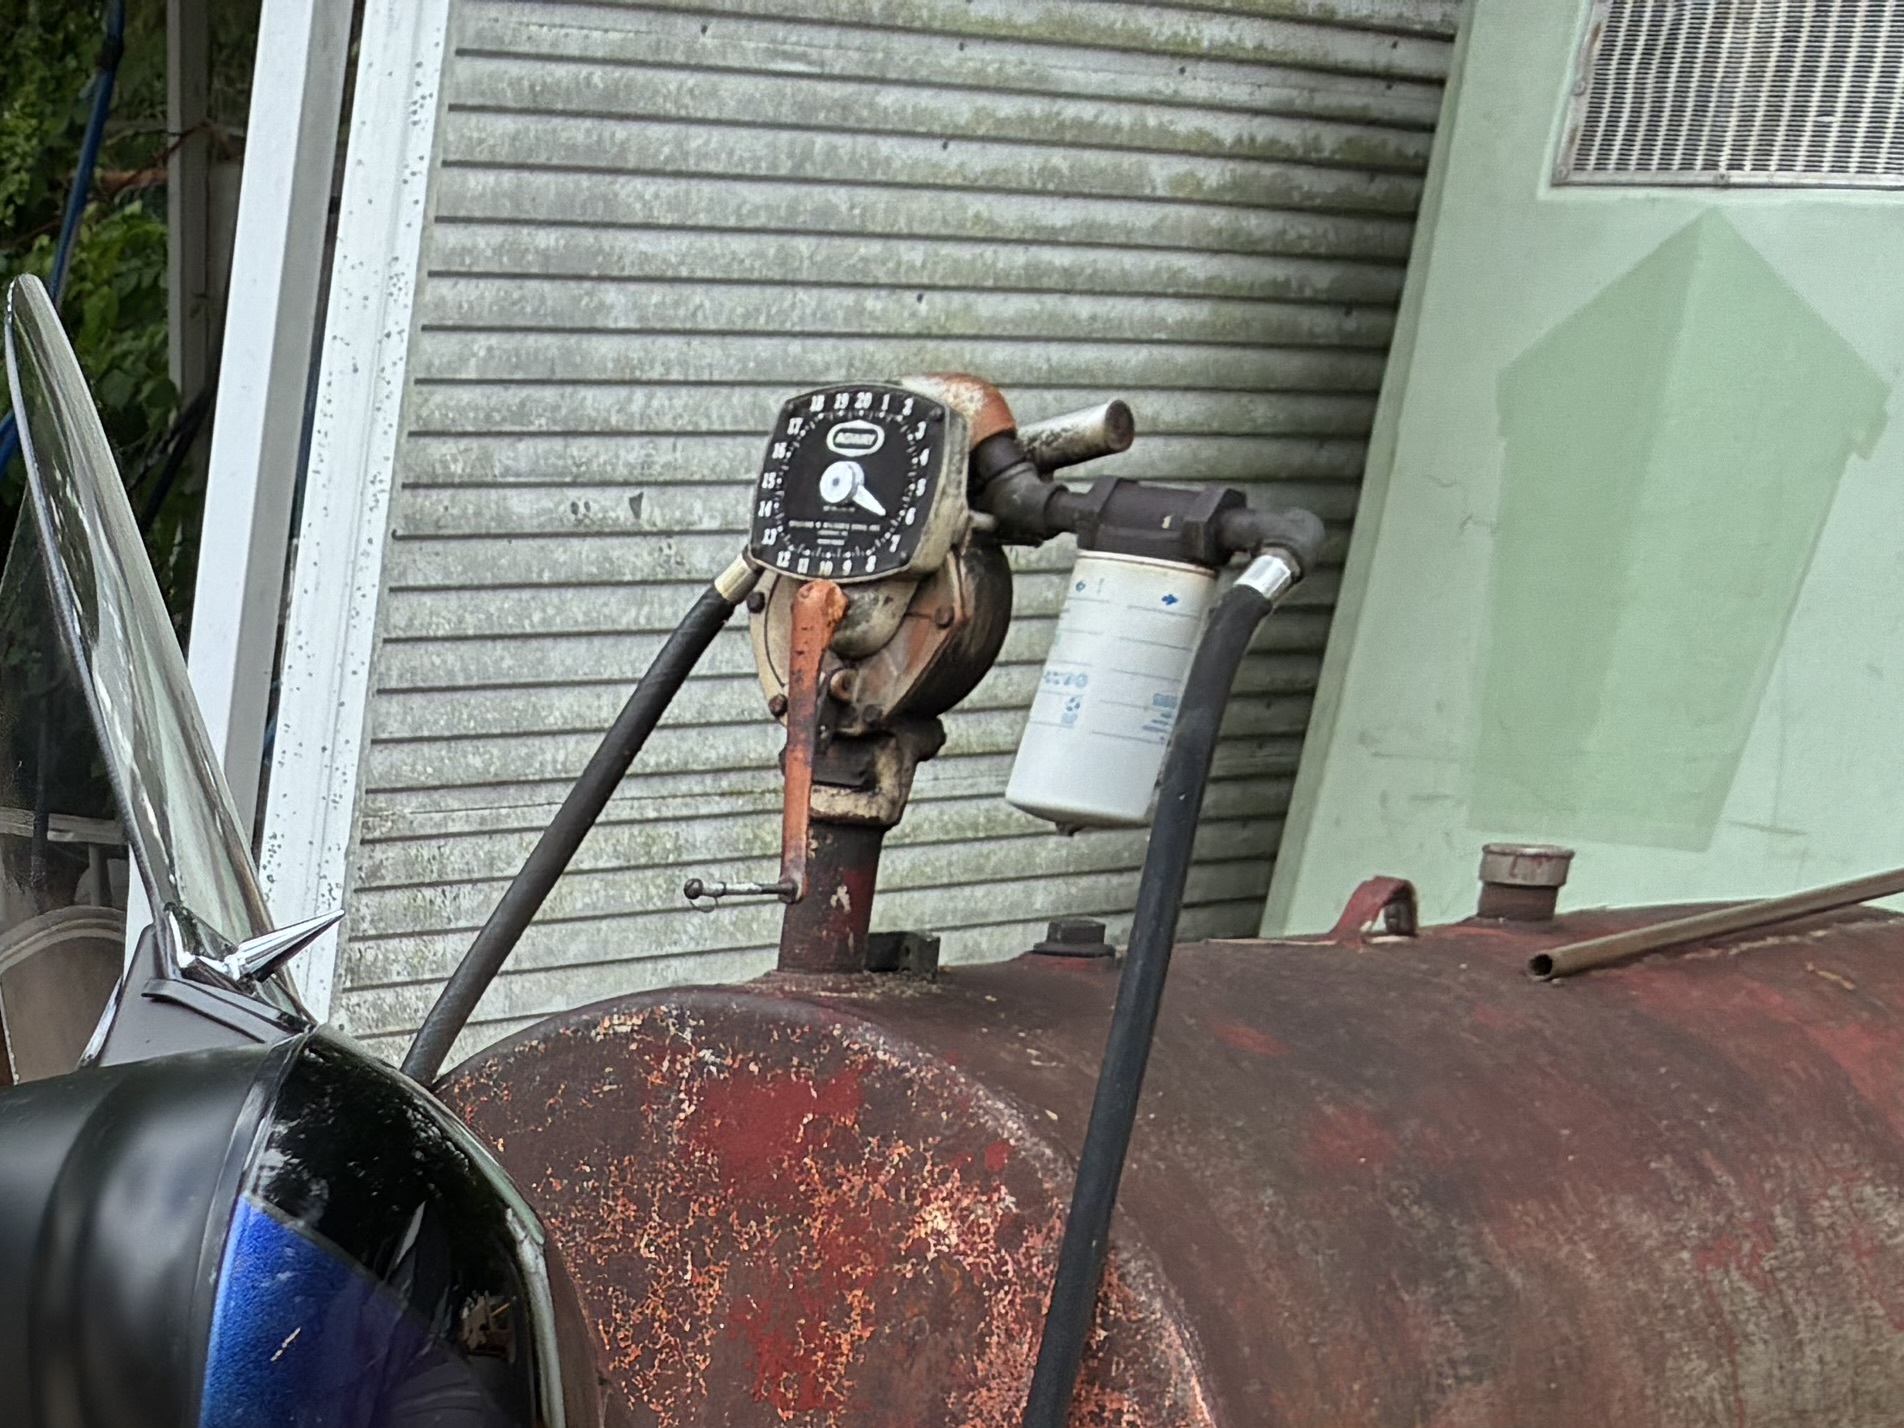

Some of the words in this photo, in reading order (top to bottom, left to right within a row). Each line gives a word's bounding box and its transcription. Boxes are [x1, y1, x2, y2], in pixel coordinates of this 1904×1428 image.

[834, 392, 850, 409] 19
[854, 391, 873, 409] 20
[881, 394, 891, 411] 1
[902, 398, 914, 416] 2
[786, 417, 804, 435] 17
[915, 421, 927, 440] 3
[771, 442, 787, 459] 16
[761, 472, 777, 489] 15
[915, 478, 927, 497] 5
[757, 500, 773, 517] 14
[904, 507, 916, 526] 6
[761, 528, 778, 545] 13
[889, 534, 901, 553] 7
[776, 550, 791, 568] 12
[797, 558, 810, 574] 11
[819, 560, 834, 576] 10
